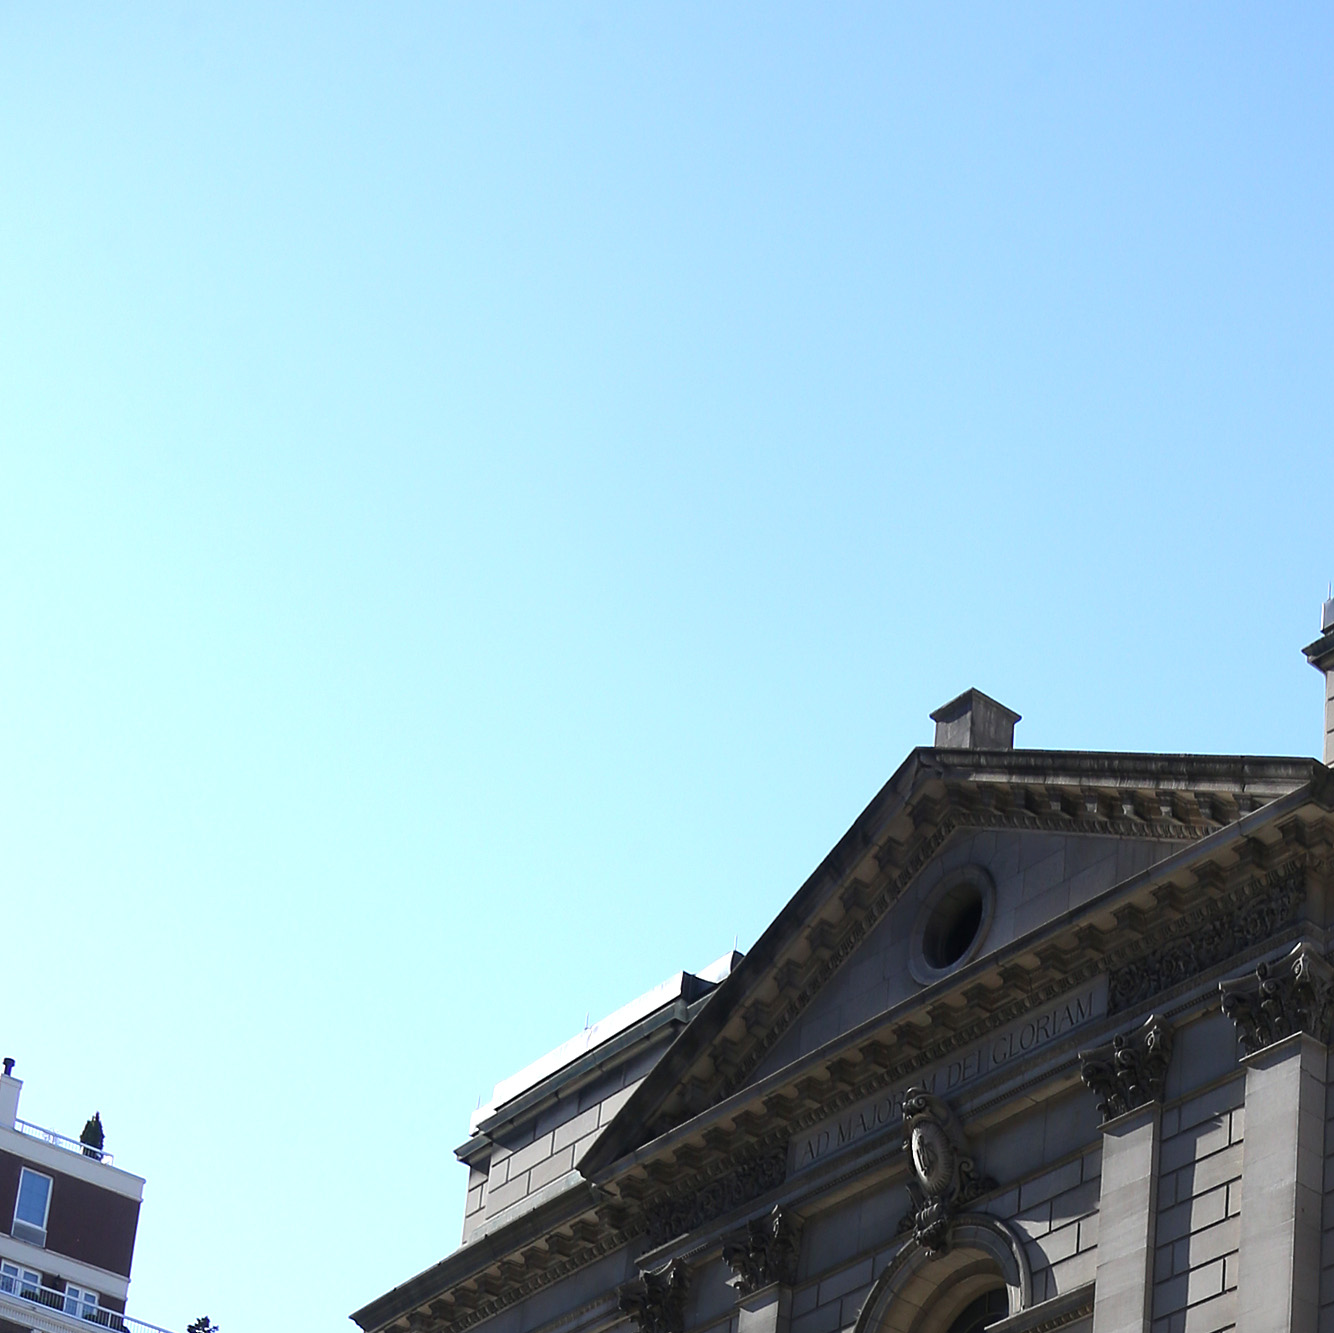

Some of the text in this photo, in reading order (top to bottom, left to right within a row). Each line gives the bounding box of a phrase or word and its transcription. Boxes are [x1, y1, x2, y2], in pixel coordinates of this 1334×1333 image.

[802, 991, 1094, 1161] AD MAJORM DEI GLORIAM
